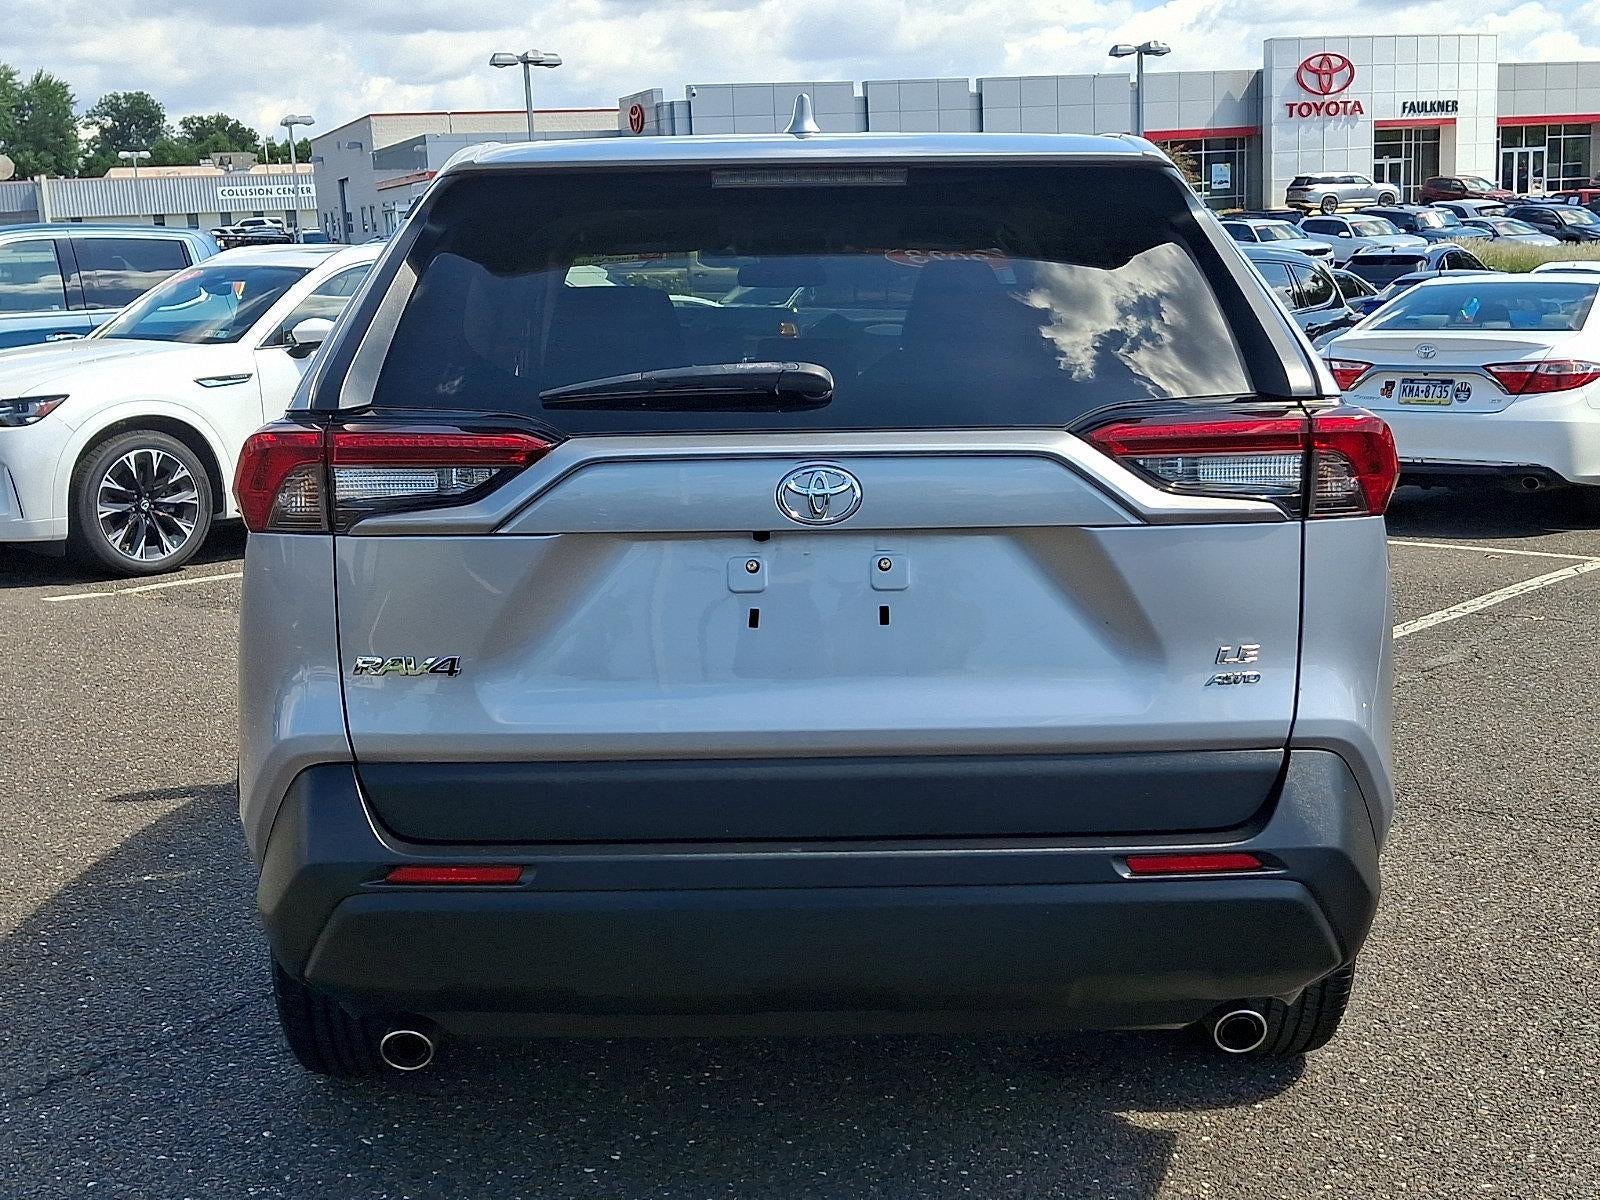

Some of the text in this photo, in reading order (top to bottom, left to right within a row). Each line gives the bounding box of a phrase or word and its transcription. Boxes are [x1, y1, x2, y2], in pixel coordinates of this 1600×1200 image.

[1285, 100, 1364, 118] TOYOTA
[1402, 99, 1459, 115] FAULKNER
[220, 186, 312, 197] COLLISION CENER
[1215, 643, 1261, 664] LE
[353, 655, 462, 678] RAV4
[1204, 670, 1261, 686] AWD
